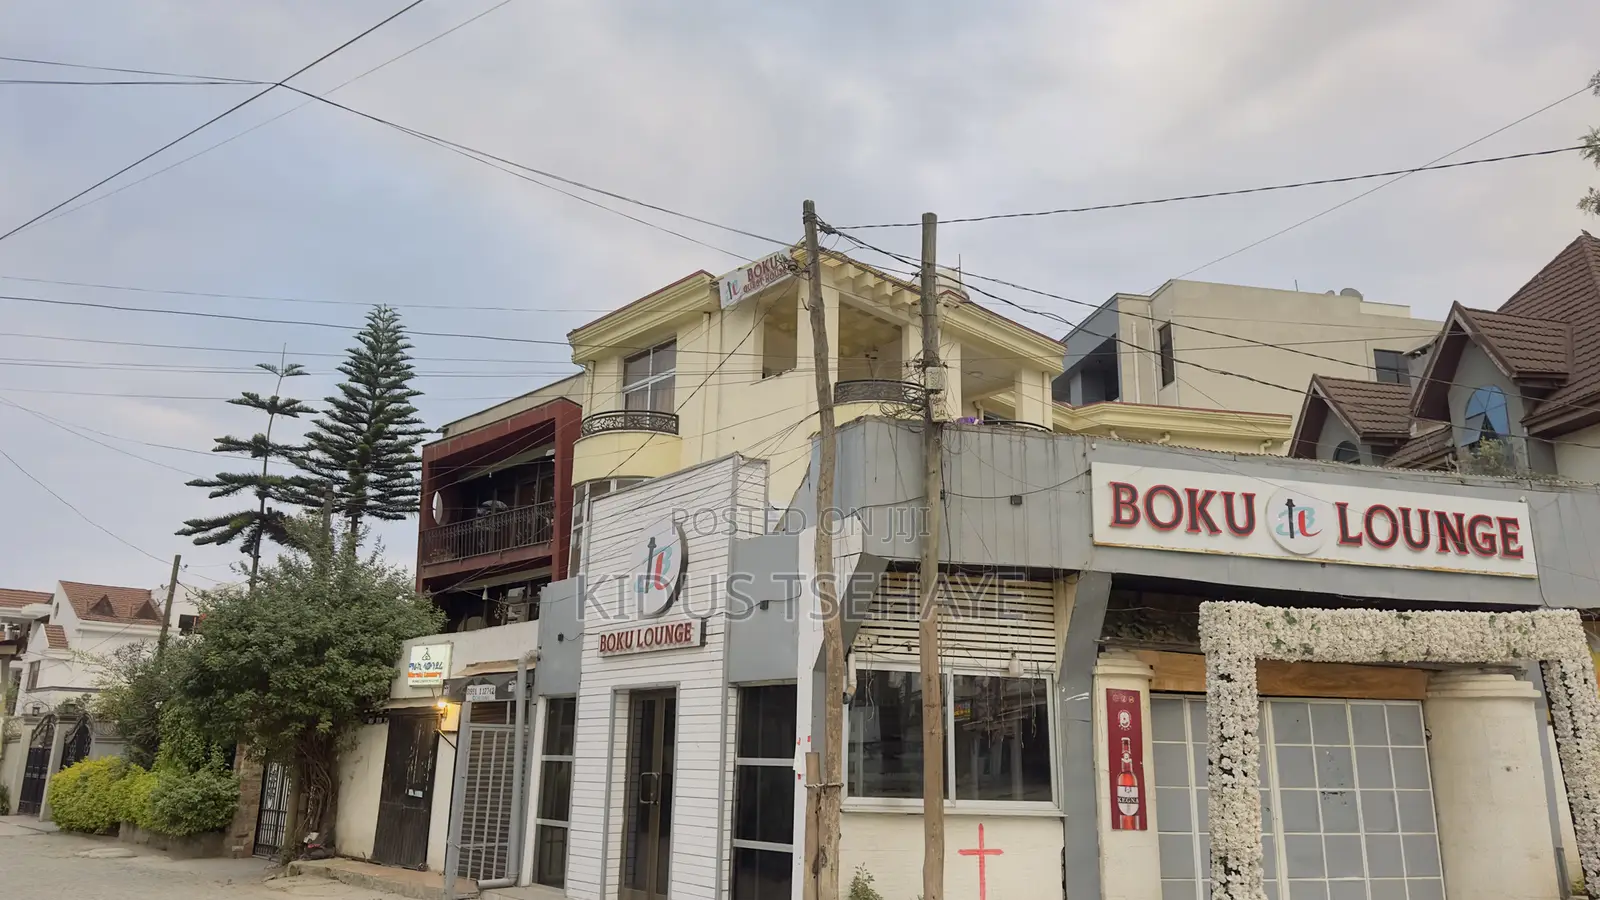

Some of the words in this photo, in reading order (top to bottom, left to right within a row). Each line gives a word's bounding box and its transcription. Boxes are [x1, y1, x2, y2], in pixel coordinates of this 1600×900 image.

[747, 255, 778, 282] BOKU
[1109, 481, 1257, 537] BOKU
[1334, 501, 1525, 559] LOUNGE
[599, 630, 636, 653] BOKU
[636, 622, 693, 648] LOUNGE
